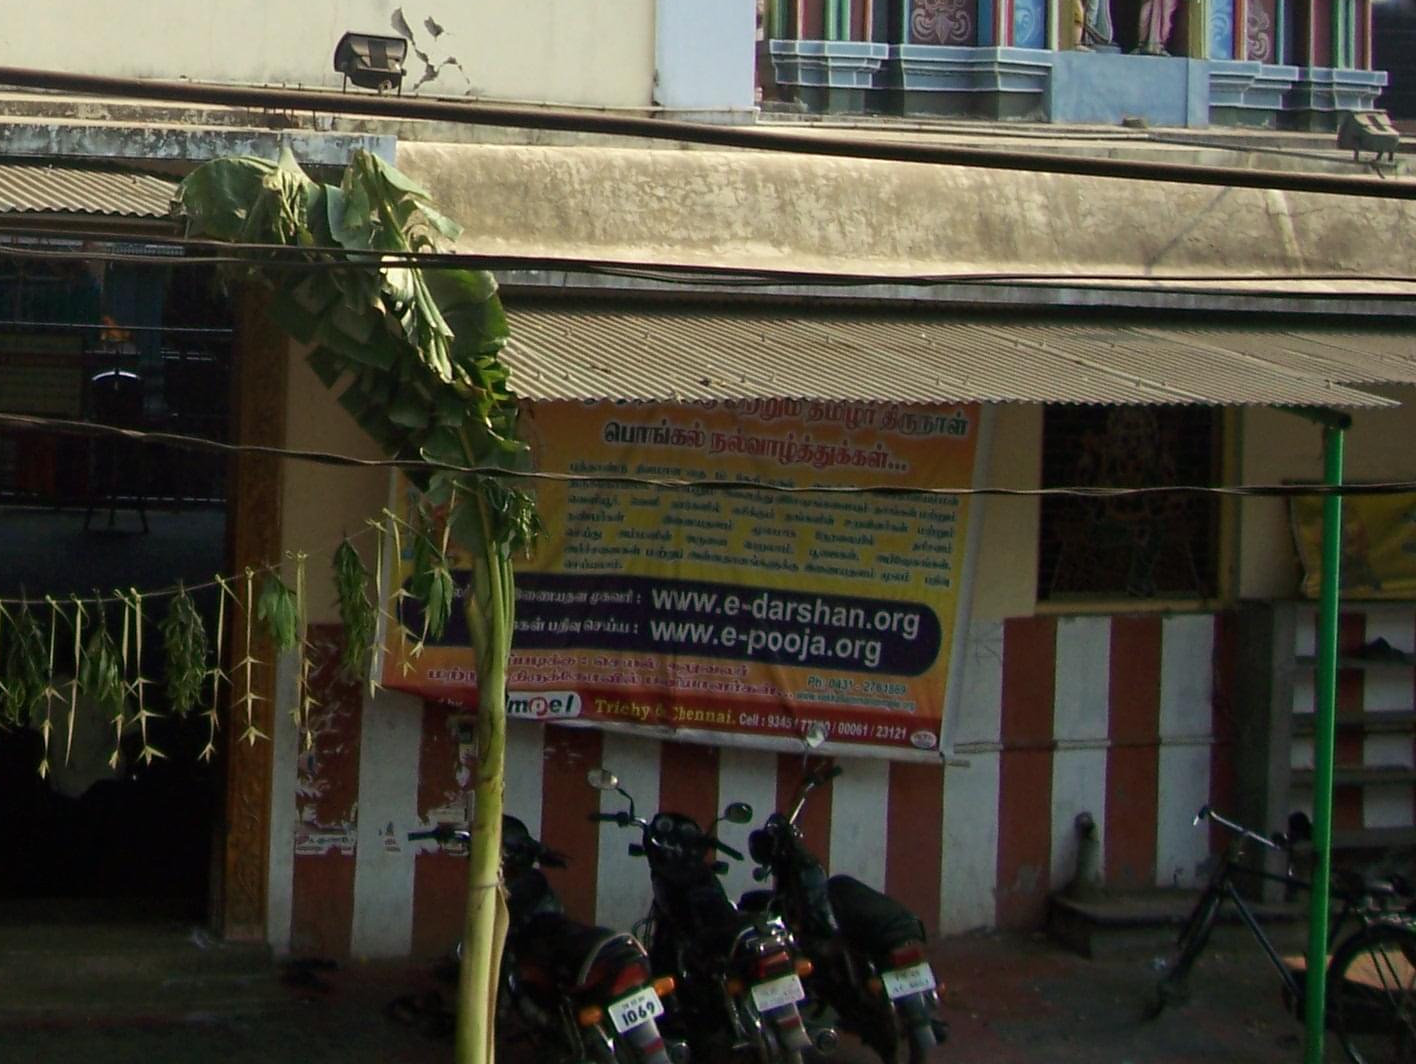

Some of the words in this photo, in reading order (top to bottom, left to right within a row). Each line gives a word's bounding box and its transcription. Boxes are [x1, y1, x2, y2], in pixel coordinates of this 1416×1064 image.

[604, 419, 706, 449] பொங்கல்
[651, 587, 921, 640] www.e-darshan.org
[649, 619, 882, 668] www.e-pooja.org
[594, 698, 650, 720] Trichy
[739, 712, 759, 726] Cell
[875, 724, 907, 740] 23121
[622, 1000, 655, 1026] 1069
